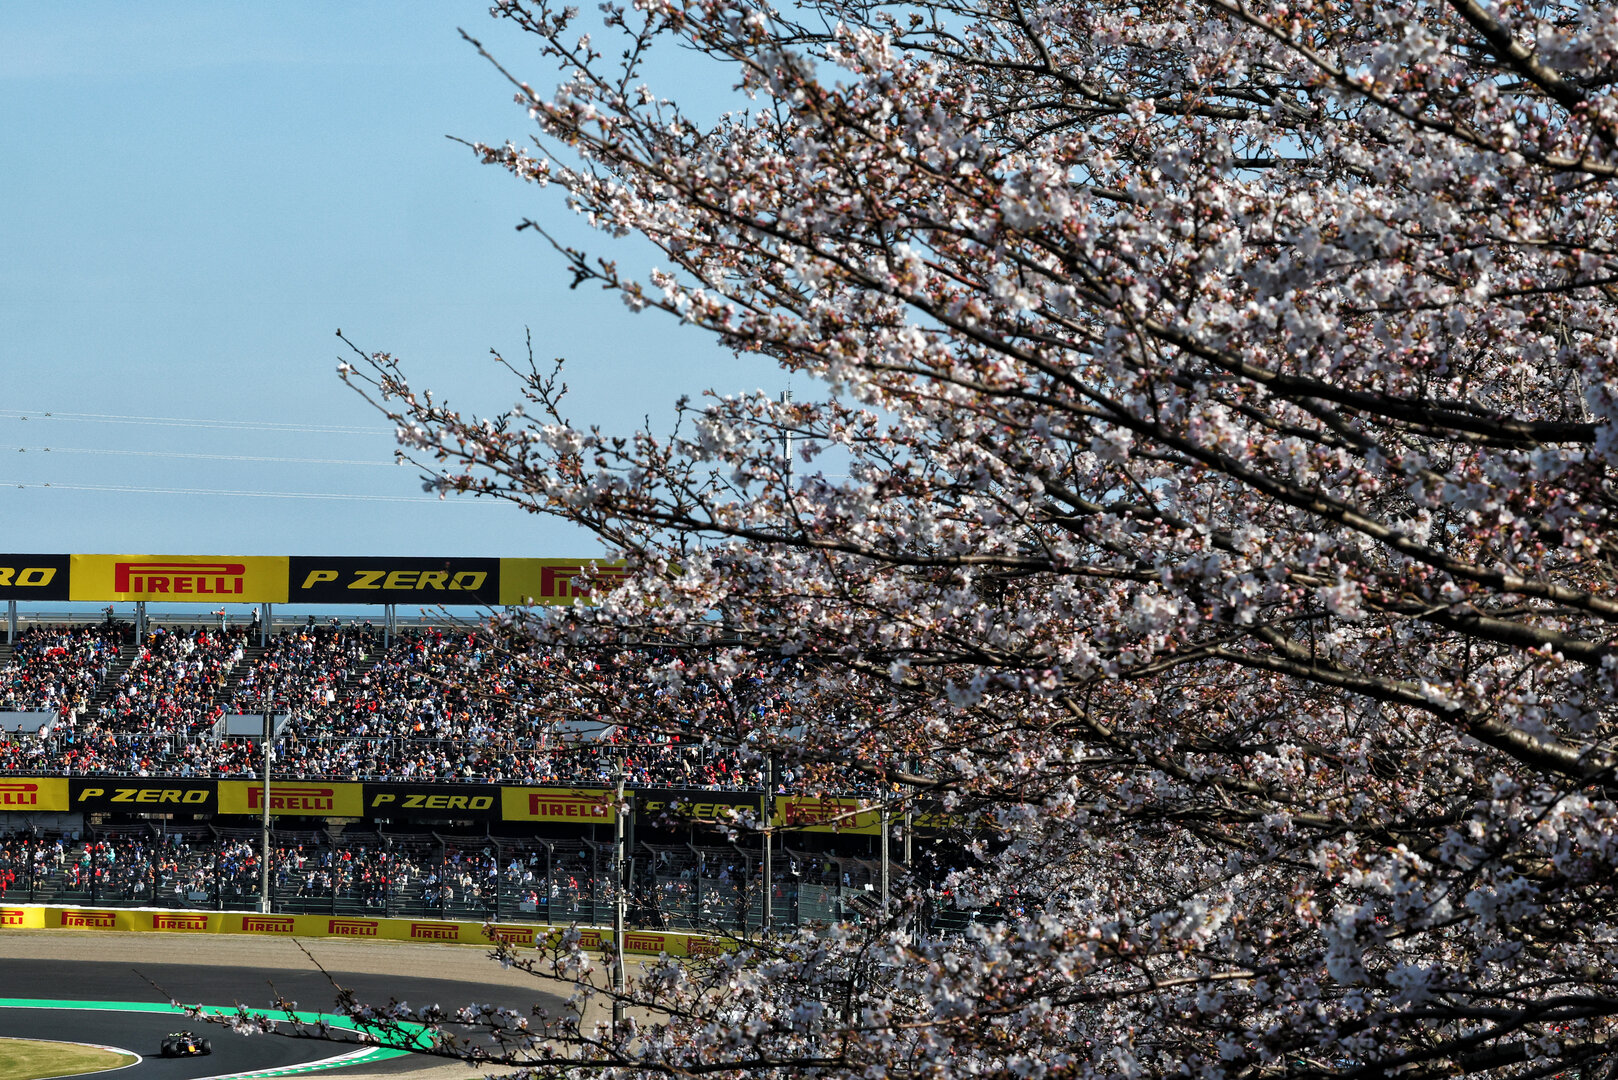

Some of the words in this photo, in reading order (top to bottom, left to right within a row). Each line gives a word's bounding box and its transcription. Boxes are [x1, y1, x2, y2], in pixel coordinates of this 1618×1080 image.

[115, 562, 246, 594] PIRELLI
[301, 570, 338, 589] P
[347, 570, 488, 590] ZERO
[77, 788, 104, 802] P
[110, 788, 210, 804] ZERO
[371, 794, 396, 808] P
[401, 794, 494, 810] ZERO
[61, 912, 116, 927] PIRELLI
[153, 914, 208, 930] PIRELLI
[242, 916, 294, 932] PIRELLI
[328, 920, 378, 936] PIRELLI
[411, 923, 459, 940] PIRELLI
[624, 934, 665, 952] PIRELLI
